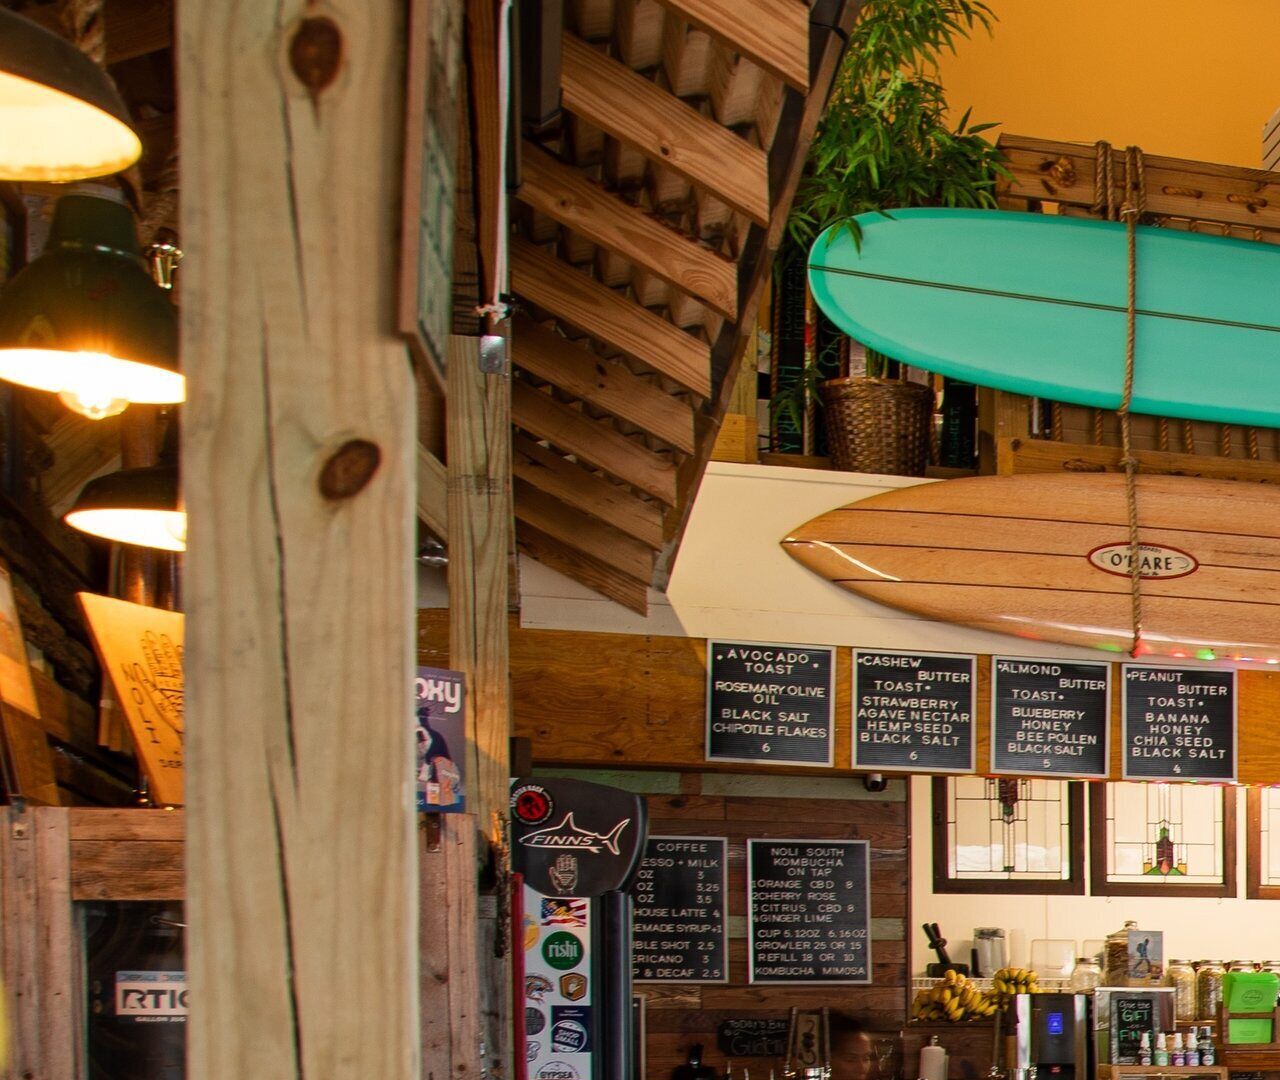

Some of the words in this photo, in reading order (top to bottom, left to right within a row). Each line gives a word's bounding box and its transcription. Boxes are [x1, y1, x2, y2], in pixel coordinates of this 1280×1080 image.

[727, 649, 809, 664] AVOCADO
[862, 655, 921, 668] CASHEW
[744, 662, 794, 675] TOAST
[1001, 663, 1061, 675] ALMOND
[918, 671, 970, 682] BUTTER
[1131, 671, 1183, 682] PEANUT
[715, 681, 786, 695] ROSEMARY
[790, 685, 825, 697] OLIVE
[874, 680, 923, 691] TOAST
[1059, 678, 1105, 690] BUTTER
[416, 677, 461, 713] oxy
[1012, 690, 1057, 701] TOAST
[1178, 685, 1227, 695] BUTTER
[753, 694, 779, 705] OIL
[862, 696, 959, 710] STRAWBERRY
[1148, 697, 1195, 707] TOAST
[722, 709, 772, 721] BLACK
[778, 711, 810, 723] SALT
[858, 708, 906, 720] AGAVE
[910, 711, 970, 722] NECTAR
[1012, 707, 1085, 720] BLUEBERRY
[1146, 713, 1210, 724] BANANA
[712, 722, 774, 735] CHIPOTLE
[777, 726, 827, 738] FLAKES
[1022, 720, 1071, 731] HONEY
[1150, 724, 1203, 735] HONEY
[861, 733, 912, 744] BLACK
[921, 735, 959, 746] SALT
[1016, 731, 1045, 742] BEE
[1048, 733, 1096, 744] POLLEN
[1134, 736, 1168, 746] CHIA
[1175, 737, 1213, 747] SEED
[762, 742, 771, 753] 6
[1008, 743, 1052, 754] BLACK
[1055, 745, 1084, 756] SALT
[1132, 747, 1181, 757] BLACK
[1188, 748, 1226, 759] SALT
[909, 750, 917, 761] 6
[1173, 764, 1181, 773] 4
[531, 835, 595, 846] FINNS
[657, 843, 708, 853] COFFEE
[771, 848, 799, 857] NOLI
[806, 848, 844, 857] SOUTH
[687, 859, 718, 868] MILK
[774, 858, 844, 867] KOMBUCHA
[787, 868, 805, 876] ON
[811, 869, 832, 877] TAP
[757, 880, 802, 889] ORANGE
[758, 892, 802, 901] CHERRY
[808, 893, 837, 901] ROSE
[672, 909, 707, 917] LATTE
[761, 904, 807, 913] CITRUS
[759, 915, 800, 923] GINGER
[804, 915, 833, 923] LIME
[548, 941, 578, 960] rishi
[661, 942, 690, 950] SHOT
[755, 941, 811, 951] GROWLER
[758, 953, 798, 963] REFILL
[657, 969, 695, 978] DECAF
[755, 967, 814, 976] KOMBUCHA
[823, 967, 865, 976] MIMOSA
